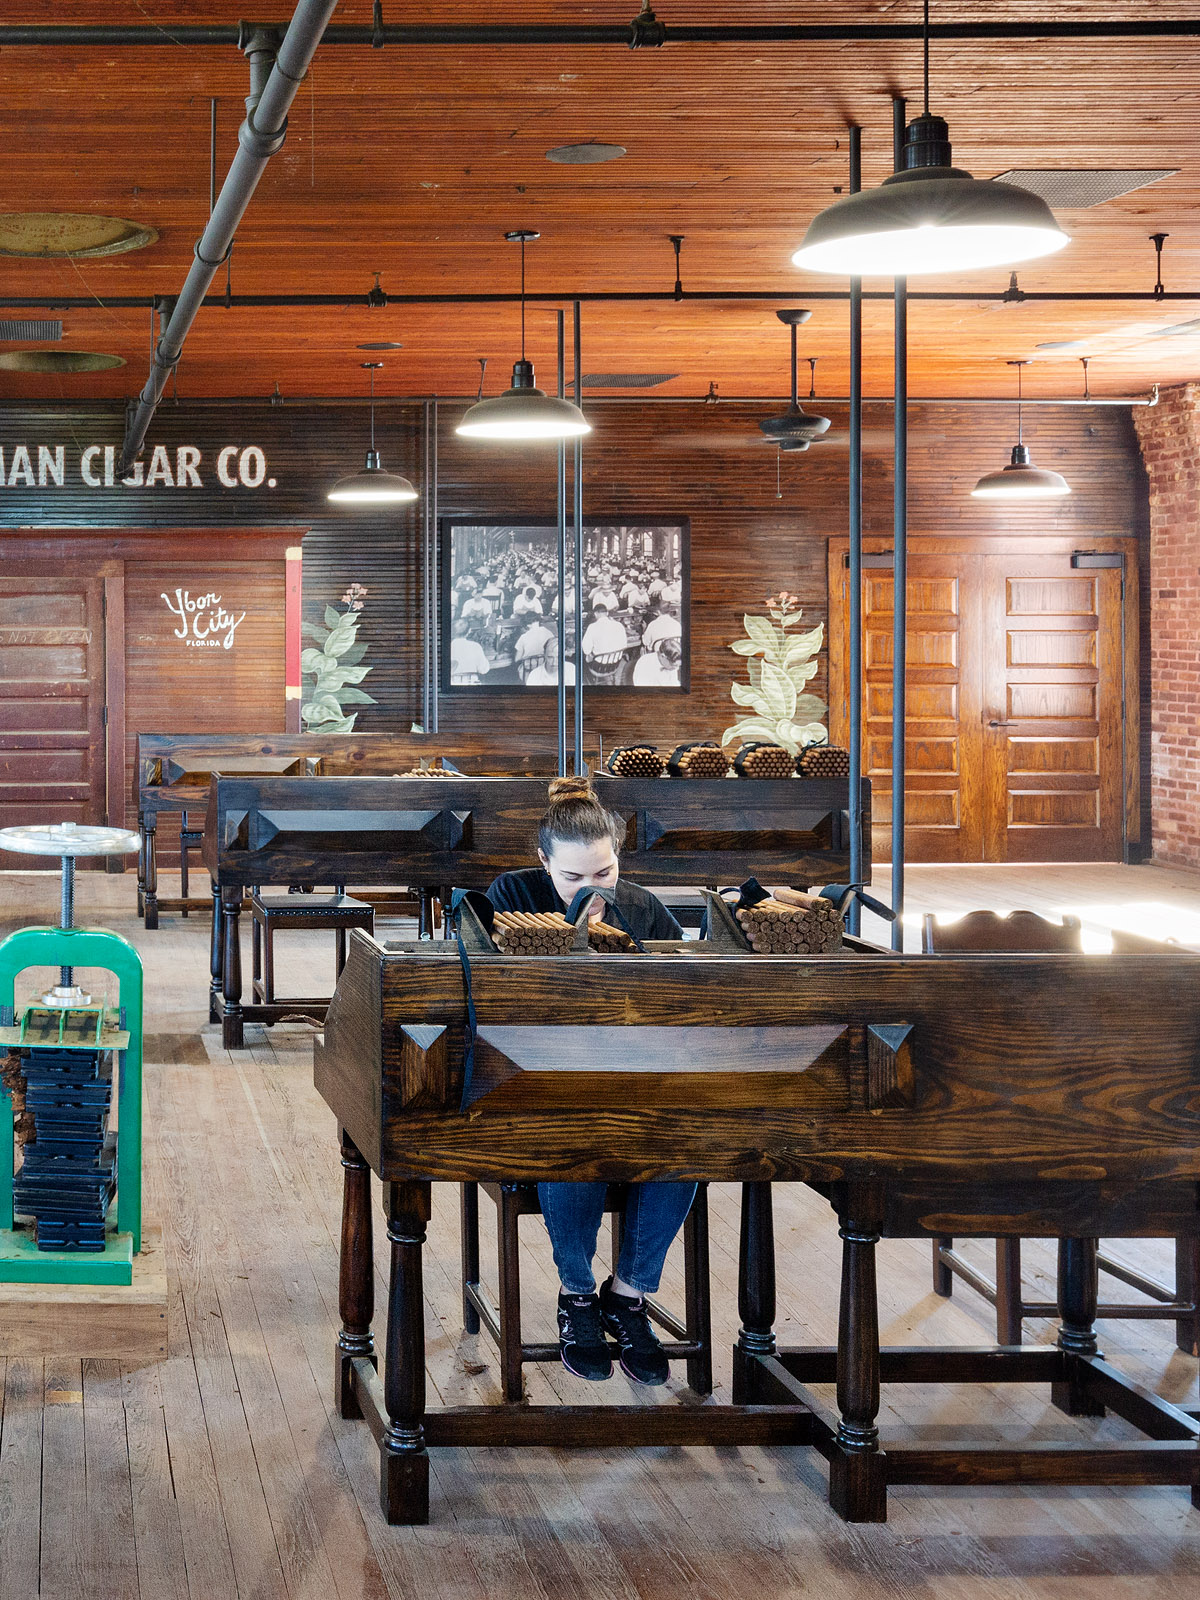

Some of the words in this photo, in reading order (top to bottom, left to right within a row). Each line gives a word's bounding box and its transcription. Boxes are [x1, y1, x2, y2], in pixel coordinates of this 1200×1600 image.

[216, 445, 277, 488] CO.
[160, 588, 221, 638] Ybor
[192, 606, 246, 649] City
